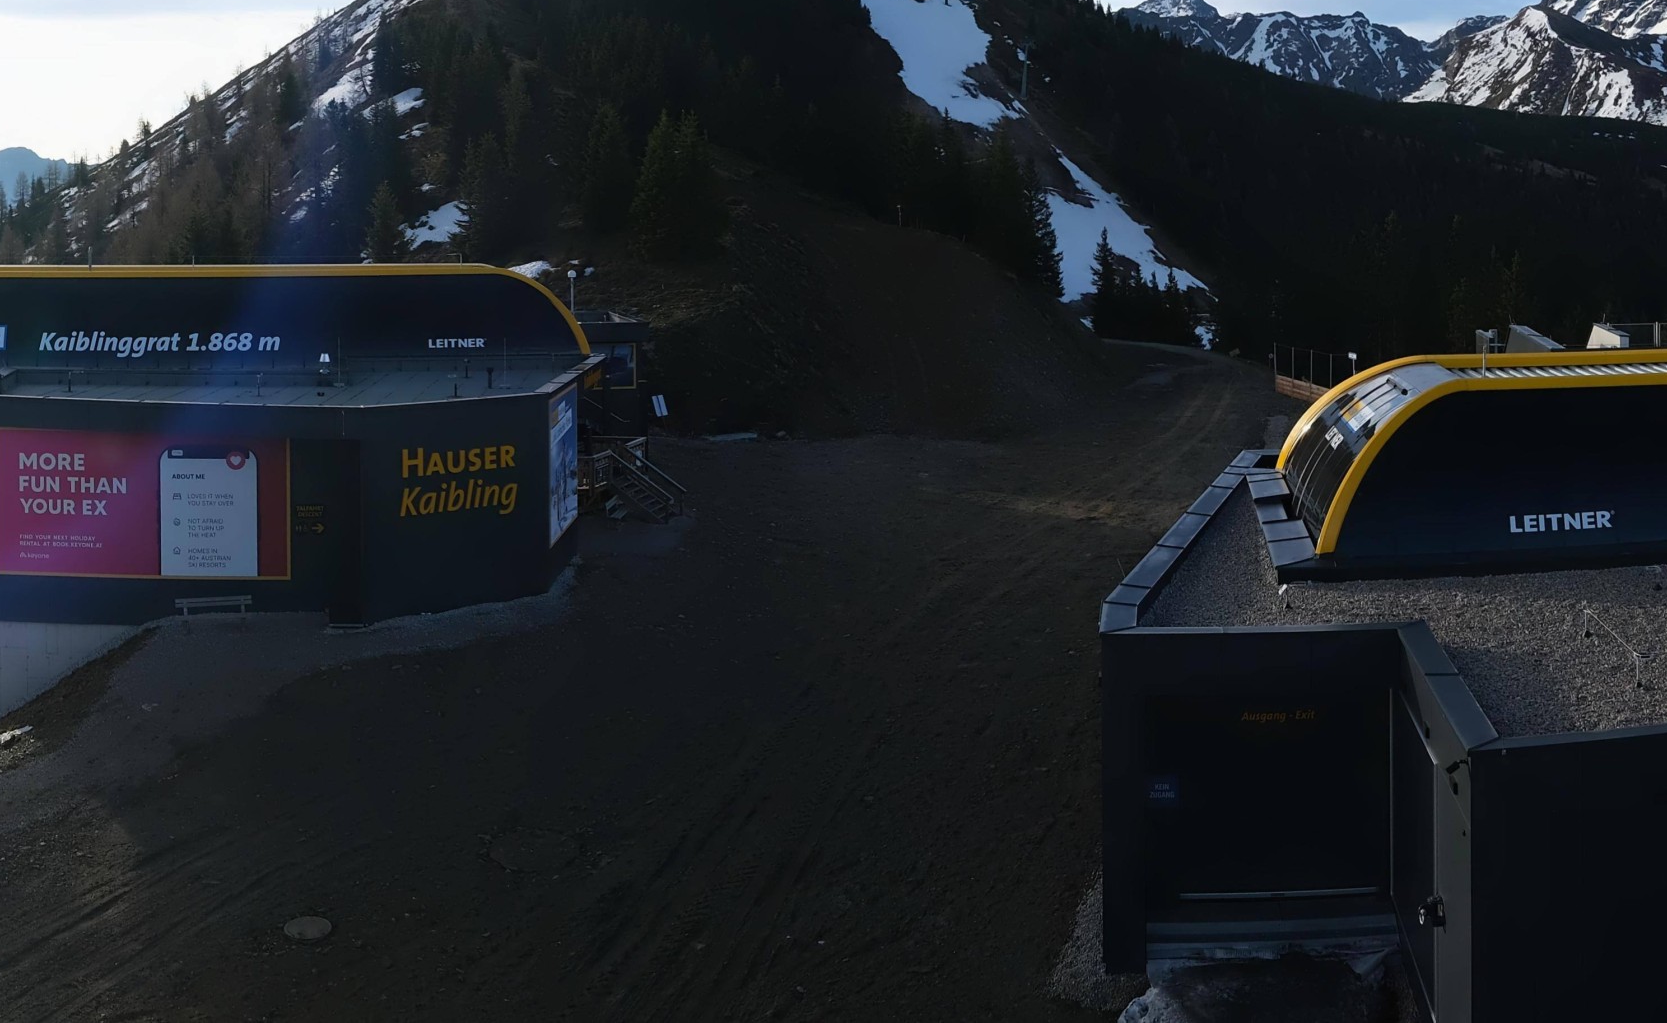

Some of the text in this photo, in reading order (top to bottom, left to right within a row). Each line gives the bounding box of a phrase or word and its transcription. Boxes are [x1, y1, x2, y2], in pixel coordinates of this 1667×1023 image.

[39, 332, 280, 358] Kaiblinggrat 1.868 m
[428, 338, 486, 348] LEITNER
[19, 452, 85, 470] MORE
[402, 446, 516, 478] HAUSER
[19, 476, 126, 494] FUN THAN
[20, 498, 108, 516] YOUR EX
[400, 480, 518, 516] Kaibling
[1510, 510, 1612, 533] LEITNER
[1241, 710, 1286, 723] Ausgang
[1295, 710, 1316, 720] Exit
